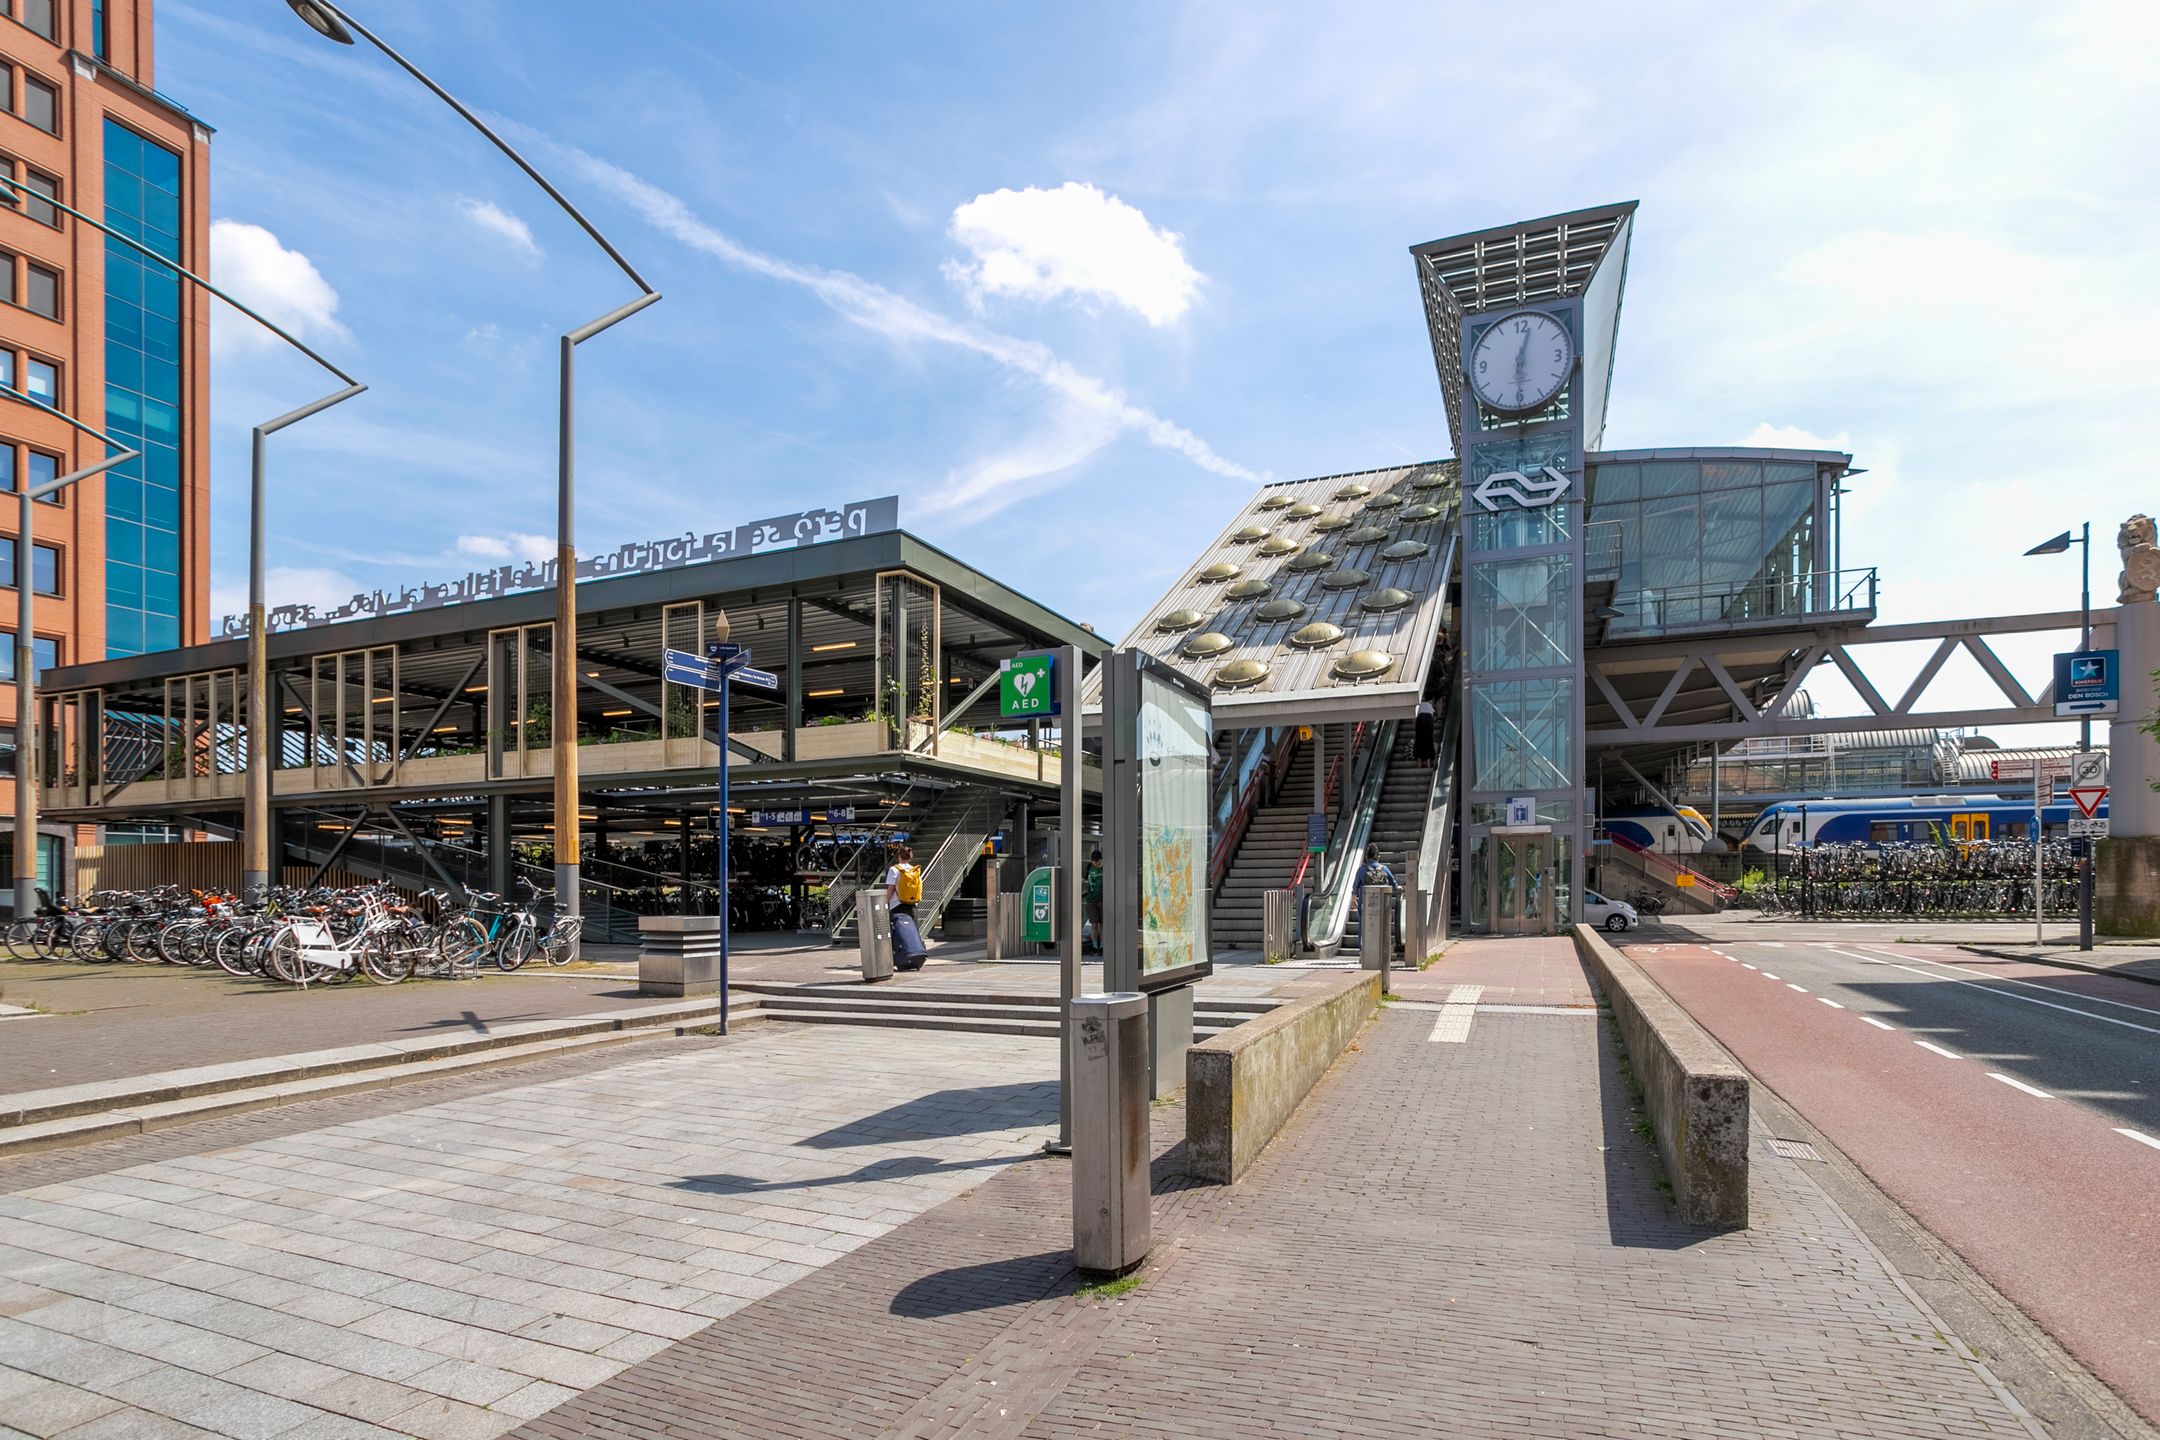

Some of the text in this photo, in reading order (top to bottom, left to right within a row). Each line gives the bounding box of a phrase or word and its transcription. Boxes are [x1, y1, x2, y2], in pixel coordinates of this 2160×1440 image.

[1514, 320, 1529, 334] 12
[1554, 349, 1562, 363] 3
[1479, 360, 1488, 374] 9
[1515, 389, 1524, 403] 6
[2085, 691, 2109, 699] BOSCH
[1012, 698, 1039, 710] AED
[2081, 765, 2098, 775] 30
[765, 812, 776, 821] 1-5
[833, 808, 846, 818] 6-8
[1903, 824, 1909, 833] 1
